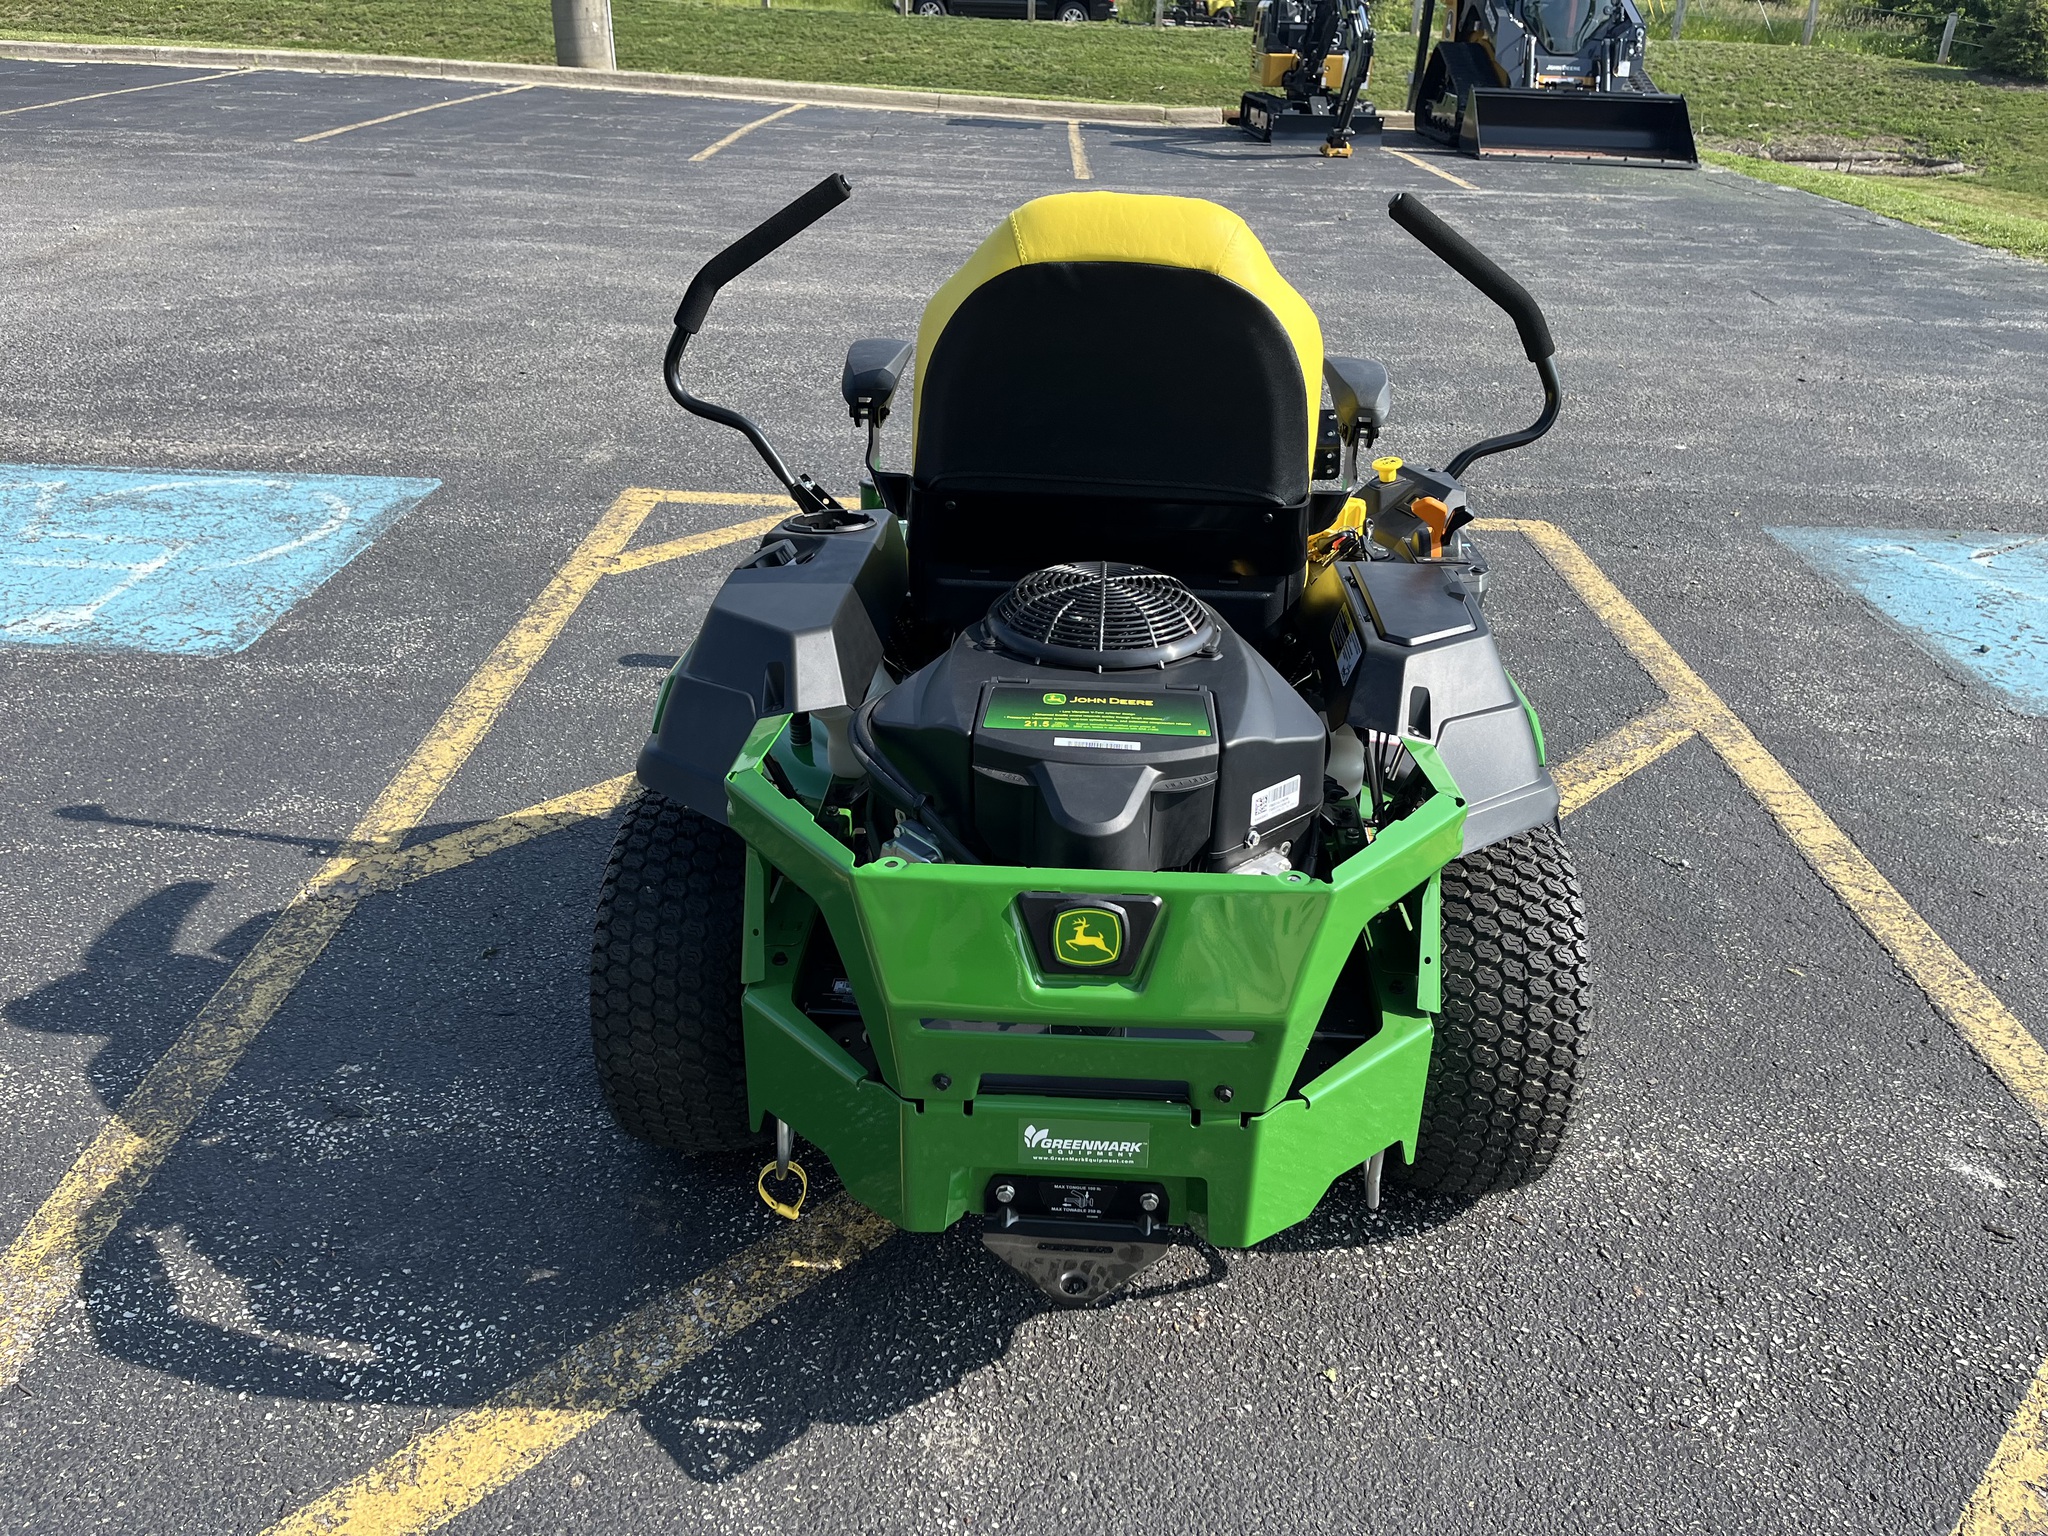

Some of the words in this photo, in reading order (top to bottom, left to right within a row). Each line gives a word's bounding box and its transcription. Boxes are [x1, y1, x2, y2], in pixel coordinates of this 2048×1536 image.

[1069, 696, 1107, 704] JOHN
[1109, 698, 1154, 706] DEERE
[1041, 1138, 1142, 1152] GREENMARK
[1047, 1149, 1133, 1157] EQUIPMENT
[1033, 1155, 1134, 1164] www.GreenMarkEquipment.com
